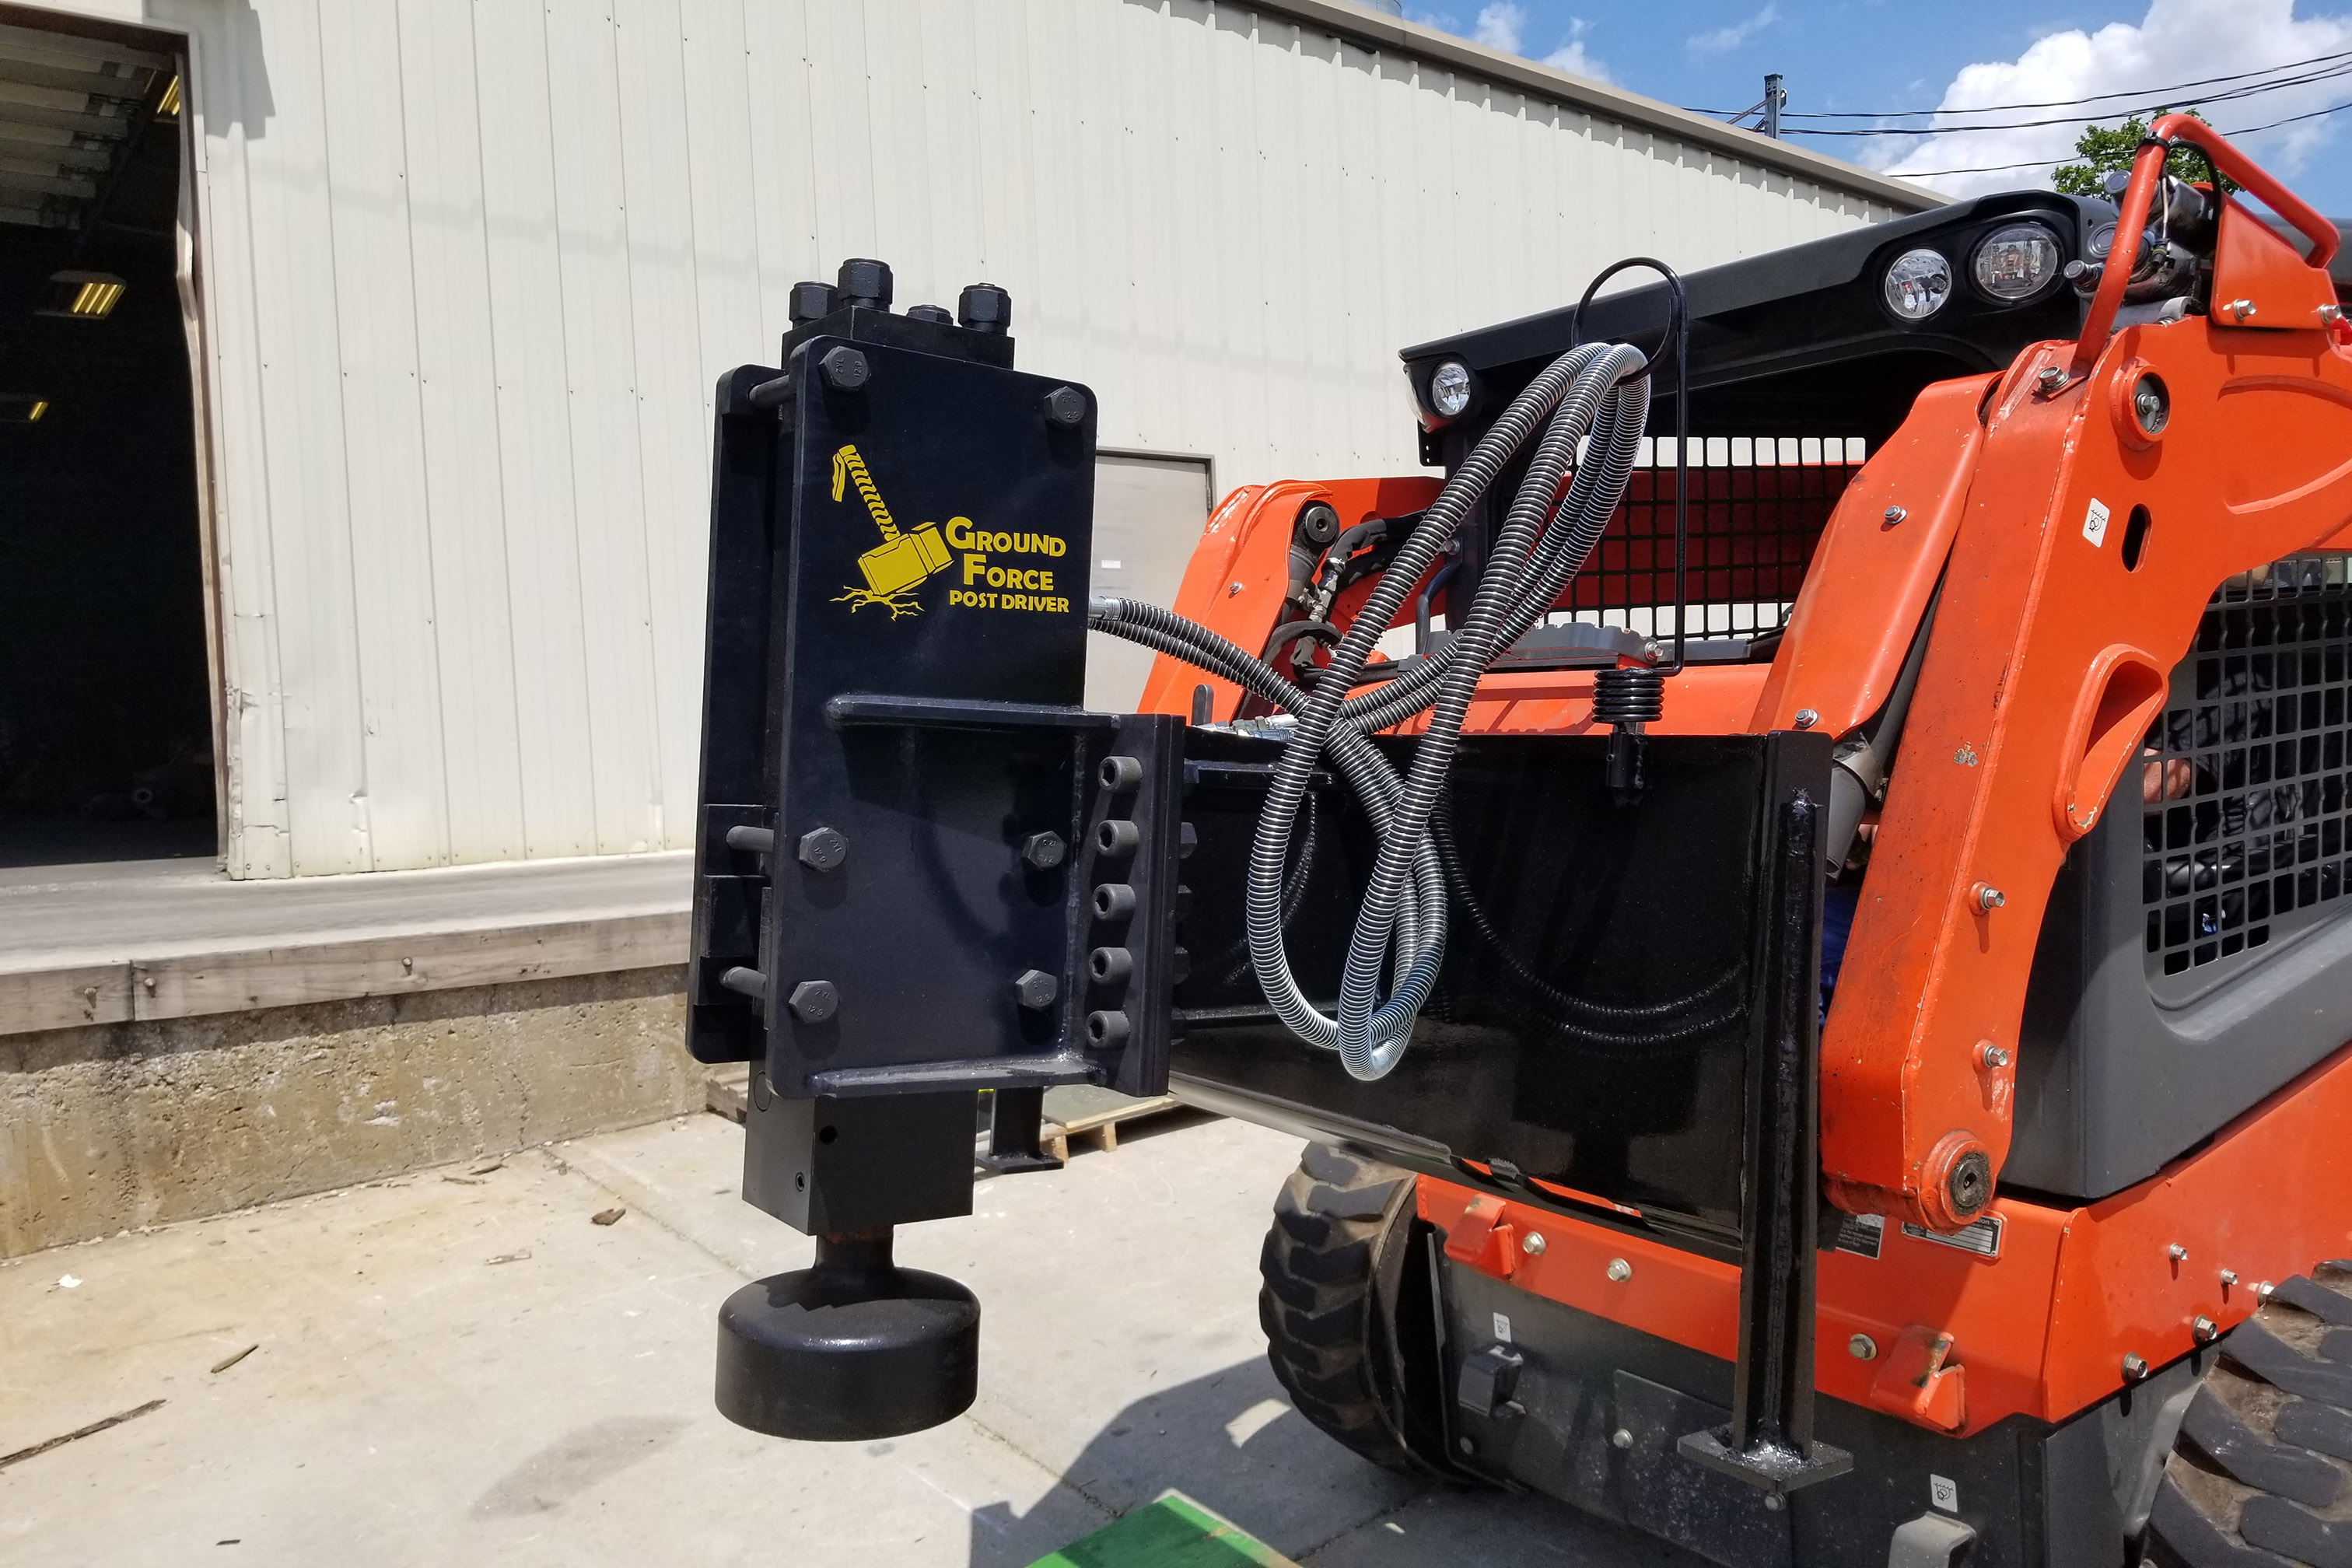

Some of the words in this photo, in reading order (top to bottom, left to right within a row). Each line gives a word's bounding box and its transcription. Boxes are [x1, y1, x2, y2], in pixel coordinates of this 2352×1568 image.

[835, 357, 845, 374] ZYL
[945, 516, 1067, 558] GROUND
[963, 552, 1055, 591] FORCE
[949, 590, 998, 609] POST
[1001, 593, 1070, 613] DRIVER
